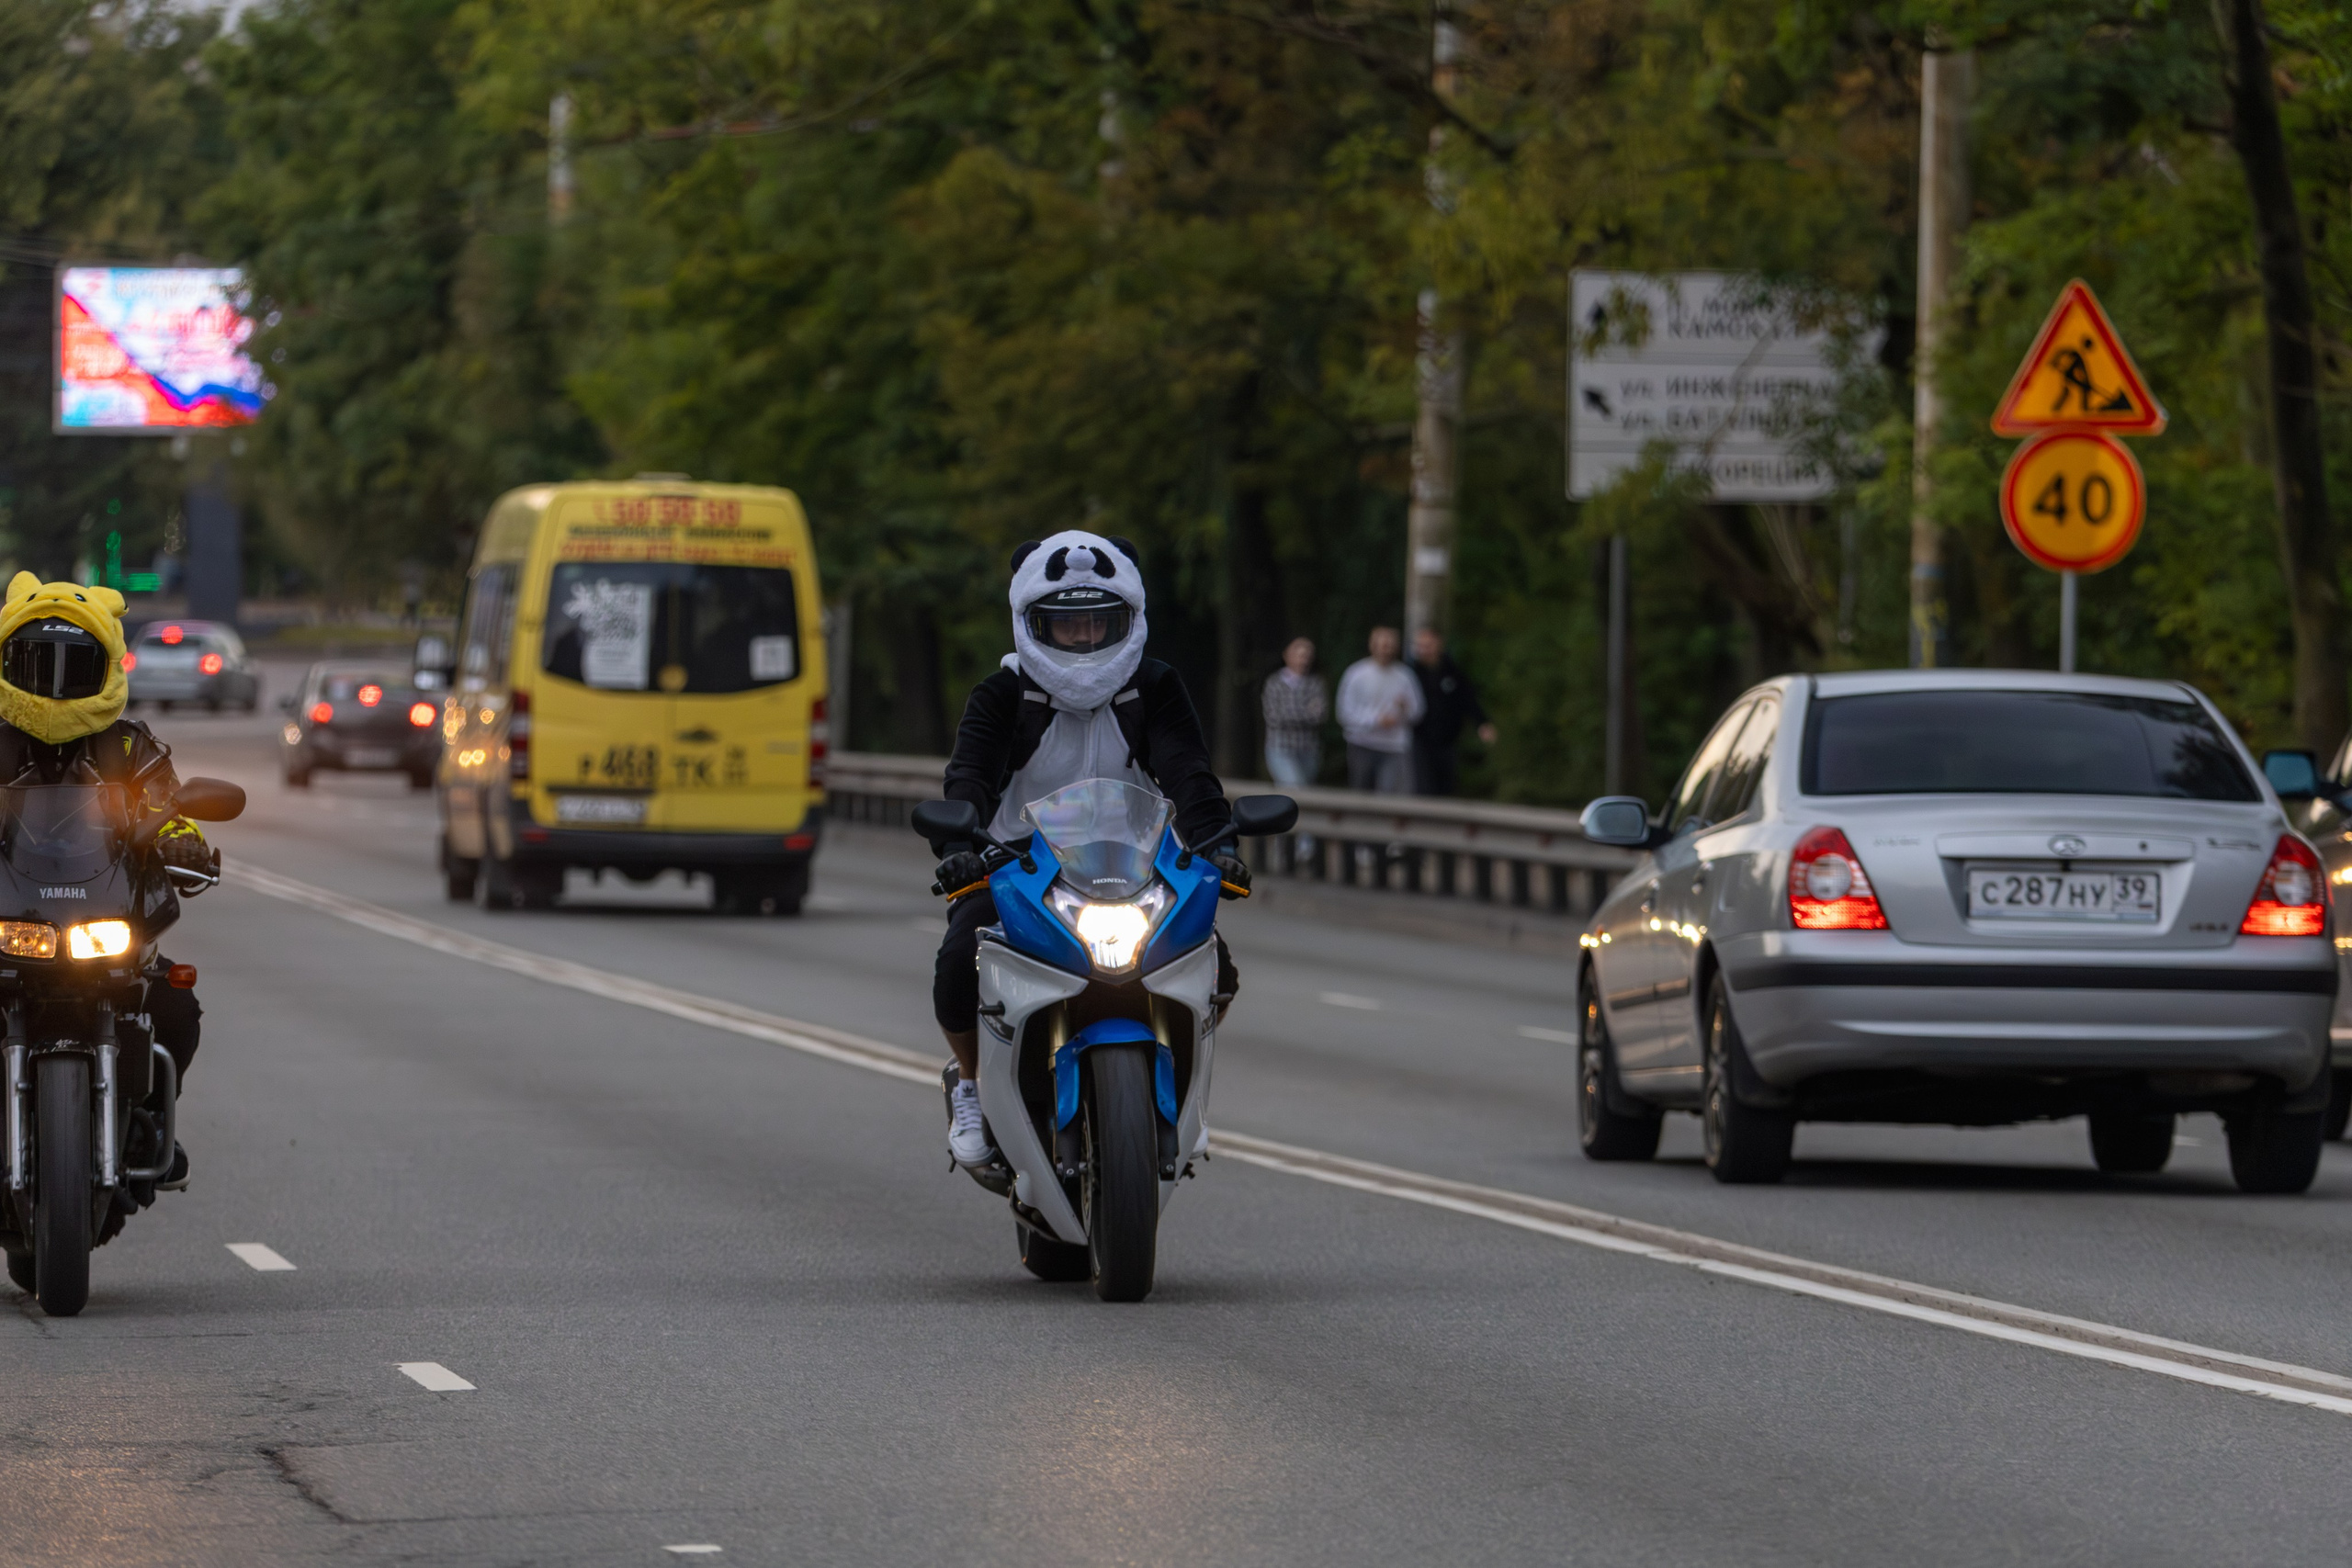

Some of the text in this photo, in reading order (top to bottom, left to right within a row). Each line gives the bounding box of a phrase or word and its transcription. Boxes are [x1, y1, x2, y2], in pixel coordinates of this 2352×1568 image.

[1667, 377, 1836, 398] ИНЖЕНЕРНА
[2034, 473, 2112, 526] 40
[1057, 591, 1104, 600] LS2
[42, 625, 85, 635] LS2
[40, 887, 87, 899] YAMAHA
[1980, 875, 2147, 907] С287НУ 39
